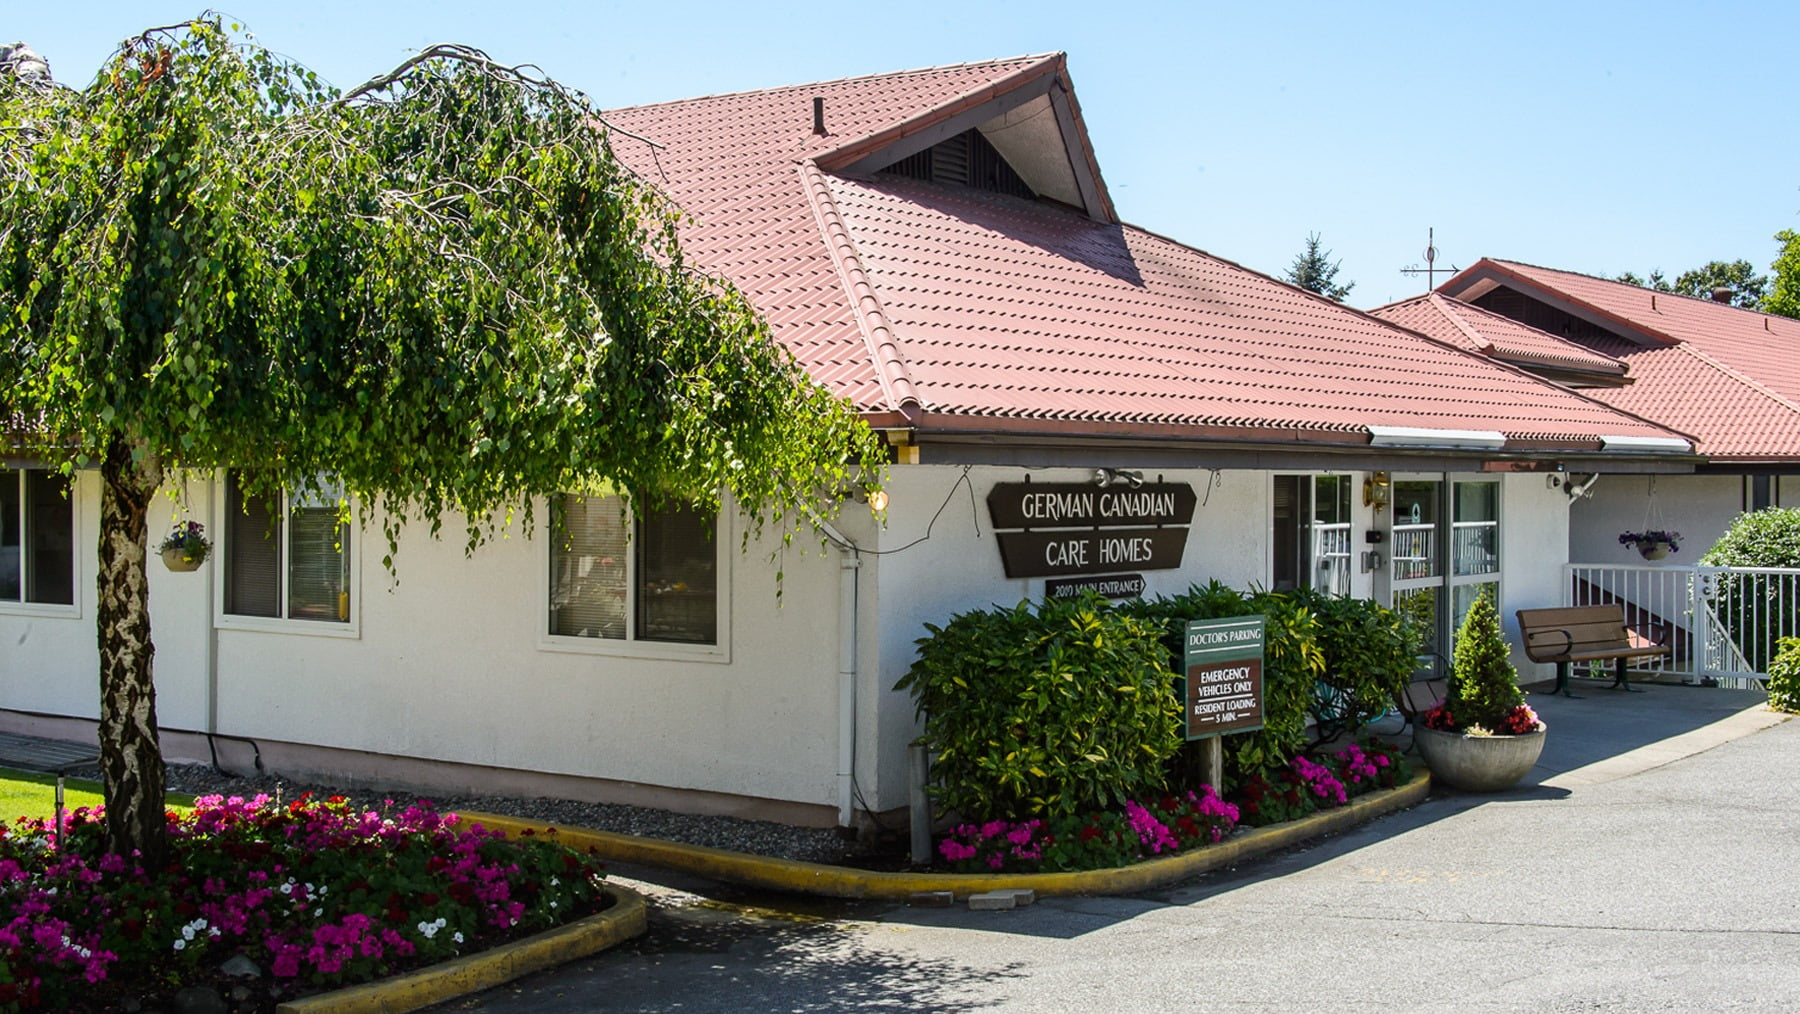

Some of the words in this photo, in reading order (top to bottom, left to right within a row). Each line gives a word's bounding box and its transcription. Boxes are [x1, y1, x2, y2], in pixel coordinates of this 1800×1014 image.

[1021, 493, 1094, 521] GERMAN
[1099, 492, 1175, 517] CANADIAN
[1046, 540, 1089, 568] CARE
[1099, 538, 1153, 564] HOMES
[1099, 580, 1139, 595] ENTRANCE
[1229, 628, 1261, 642] PARKING
[1200, 667, 1250, 683] EMERGENCY
[1198, 683, 1232, 696] VEHICLES
[1233, 681, 1252, 693] ONLY
[1194, 701, 1225, 715] RESIDENT
[1226, 698, 1256, 711] LOADING
